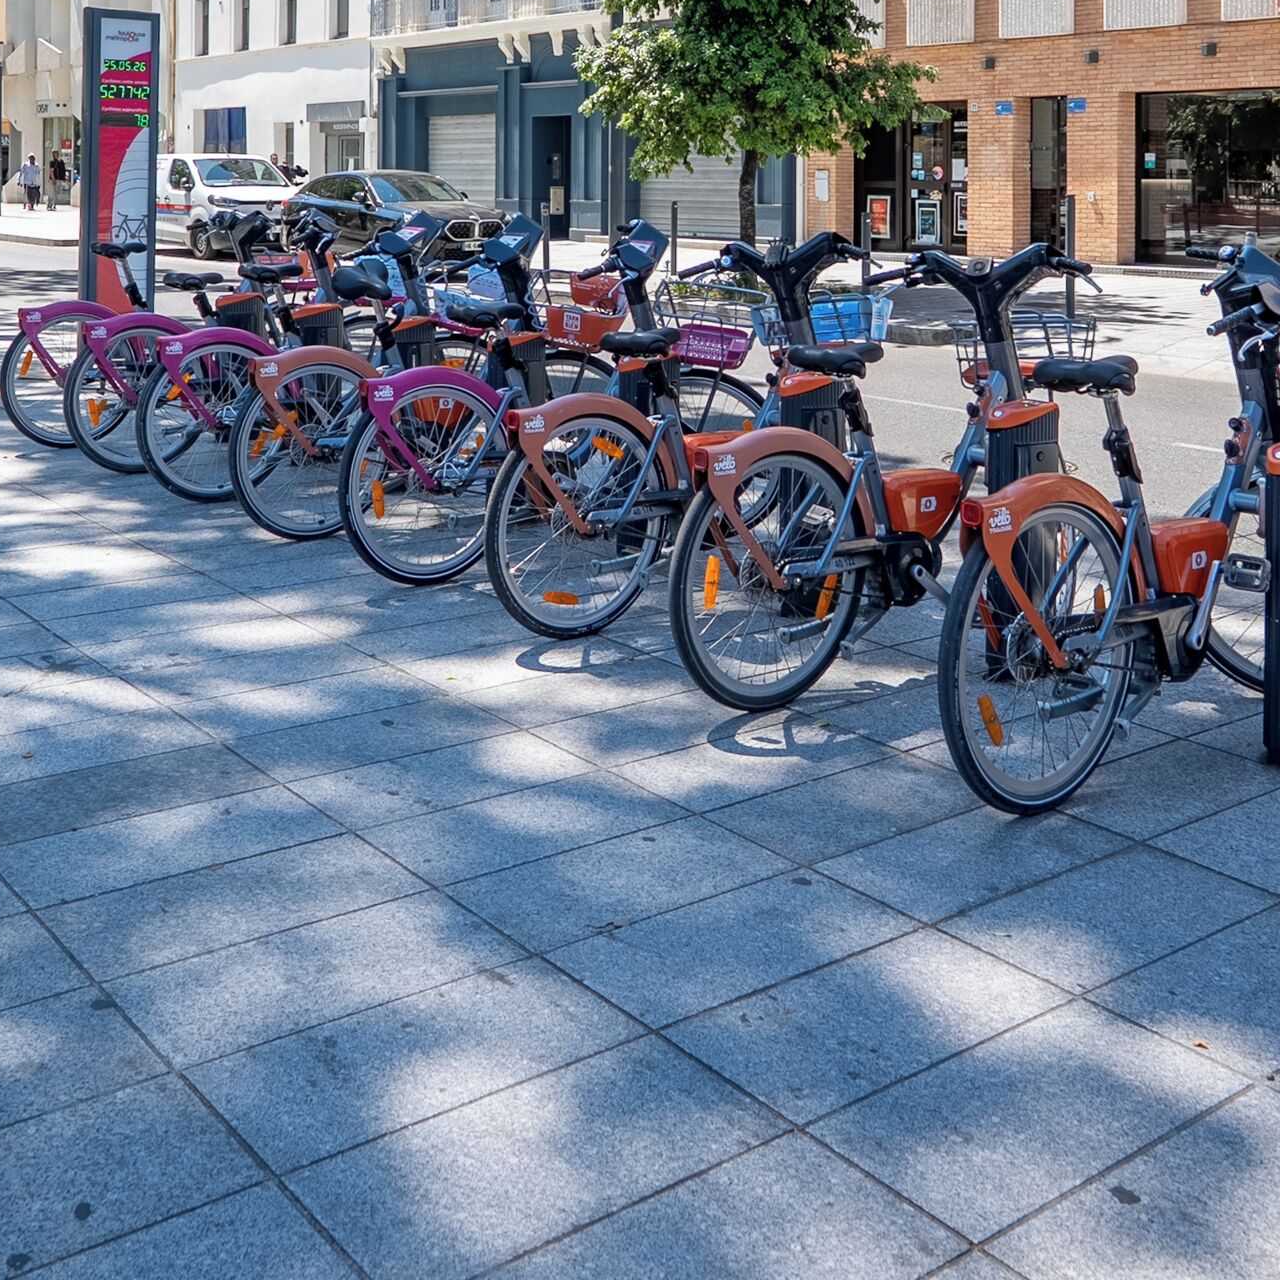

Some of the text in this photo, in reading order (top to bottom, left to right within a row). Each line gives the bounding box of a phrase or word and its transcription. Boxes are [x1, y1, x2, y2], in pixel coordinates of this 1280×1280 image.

[104, 61, 146, 71] 25.05.26
[100, 85, 150, 99] 527742
[134, 114, 150, 128] 78
